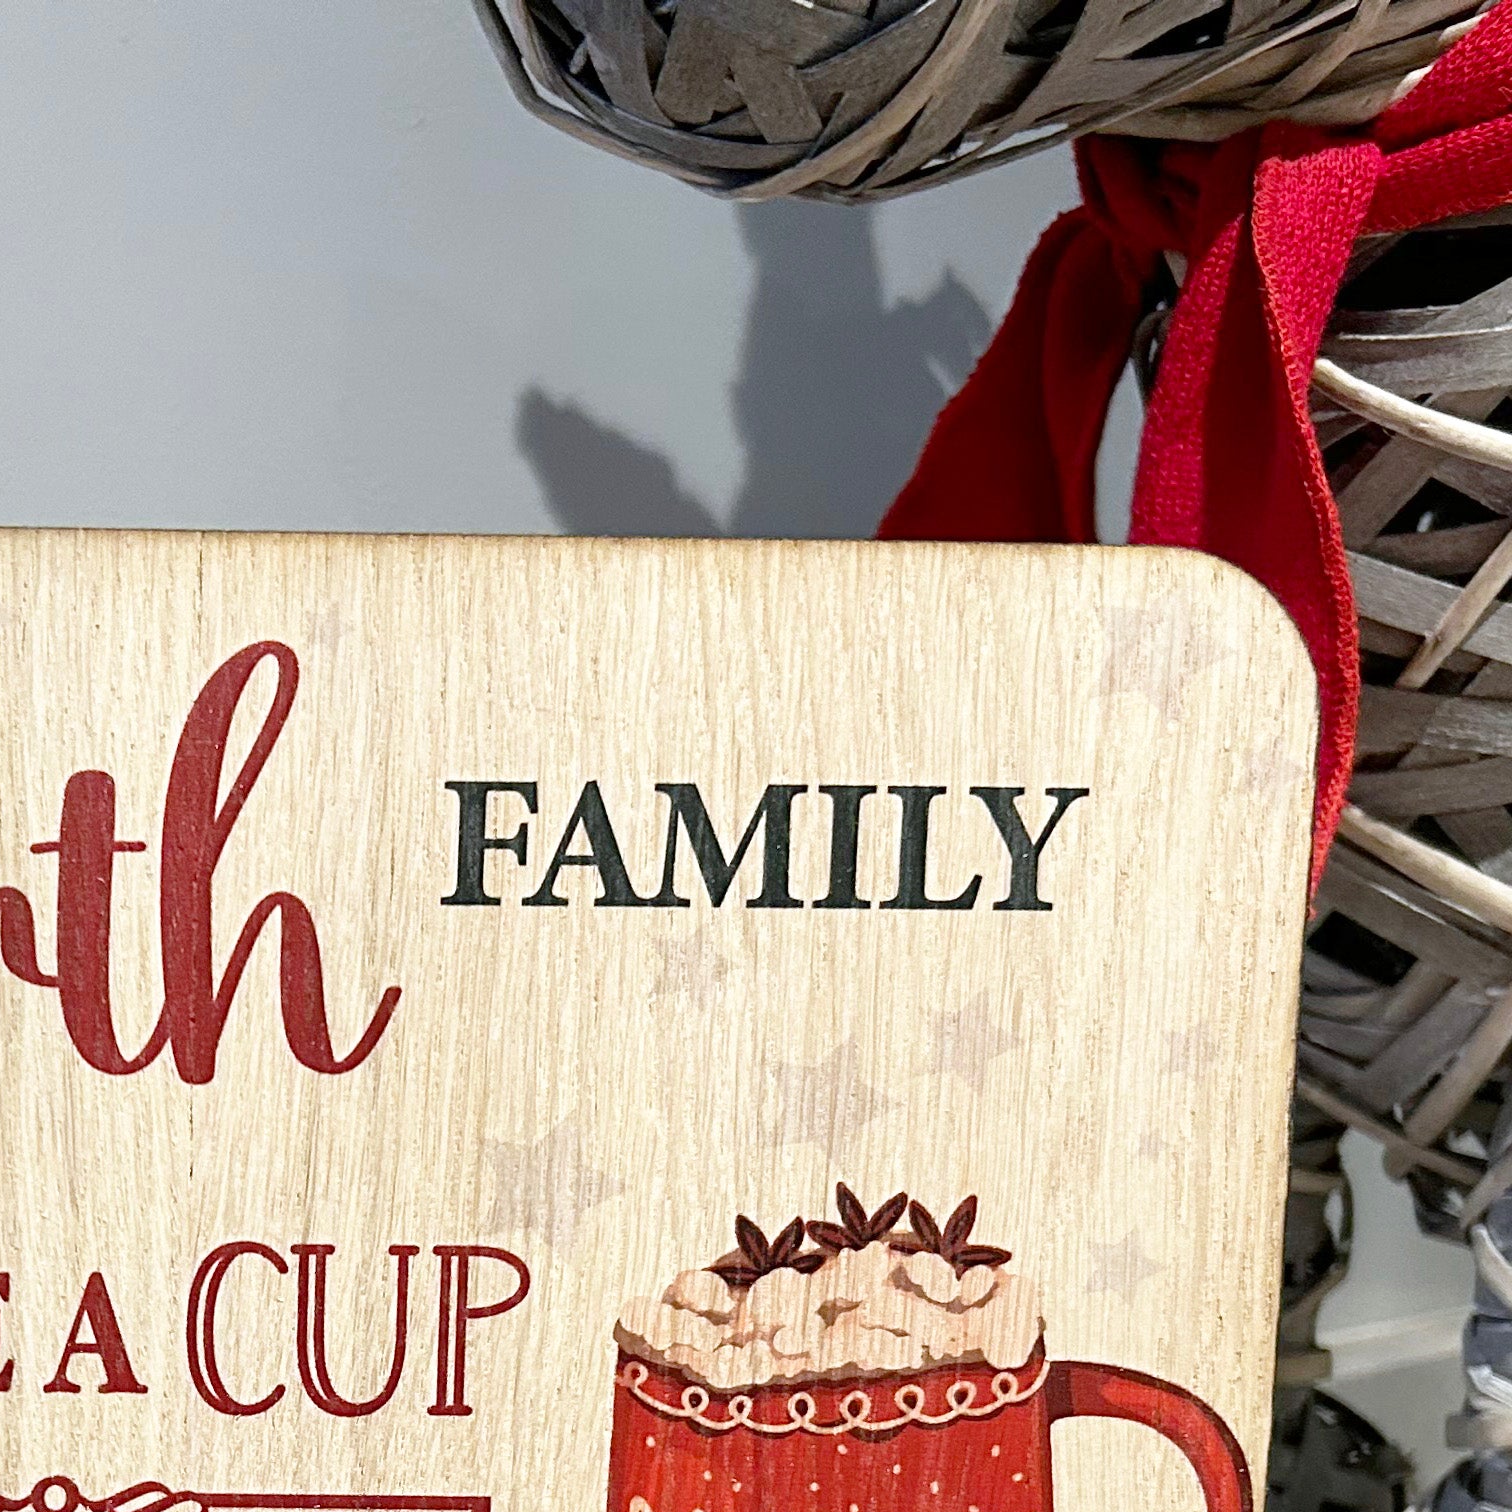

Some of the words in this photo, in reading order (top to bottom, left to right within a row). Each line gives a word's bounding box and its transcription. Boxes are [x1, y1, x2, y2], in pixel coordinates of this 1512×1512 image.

[440, 779, 1090, 911] FAMILY
[42, 1270, 148, 1396] A
[185, 1240, 532, 1419] CUP
